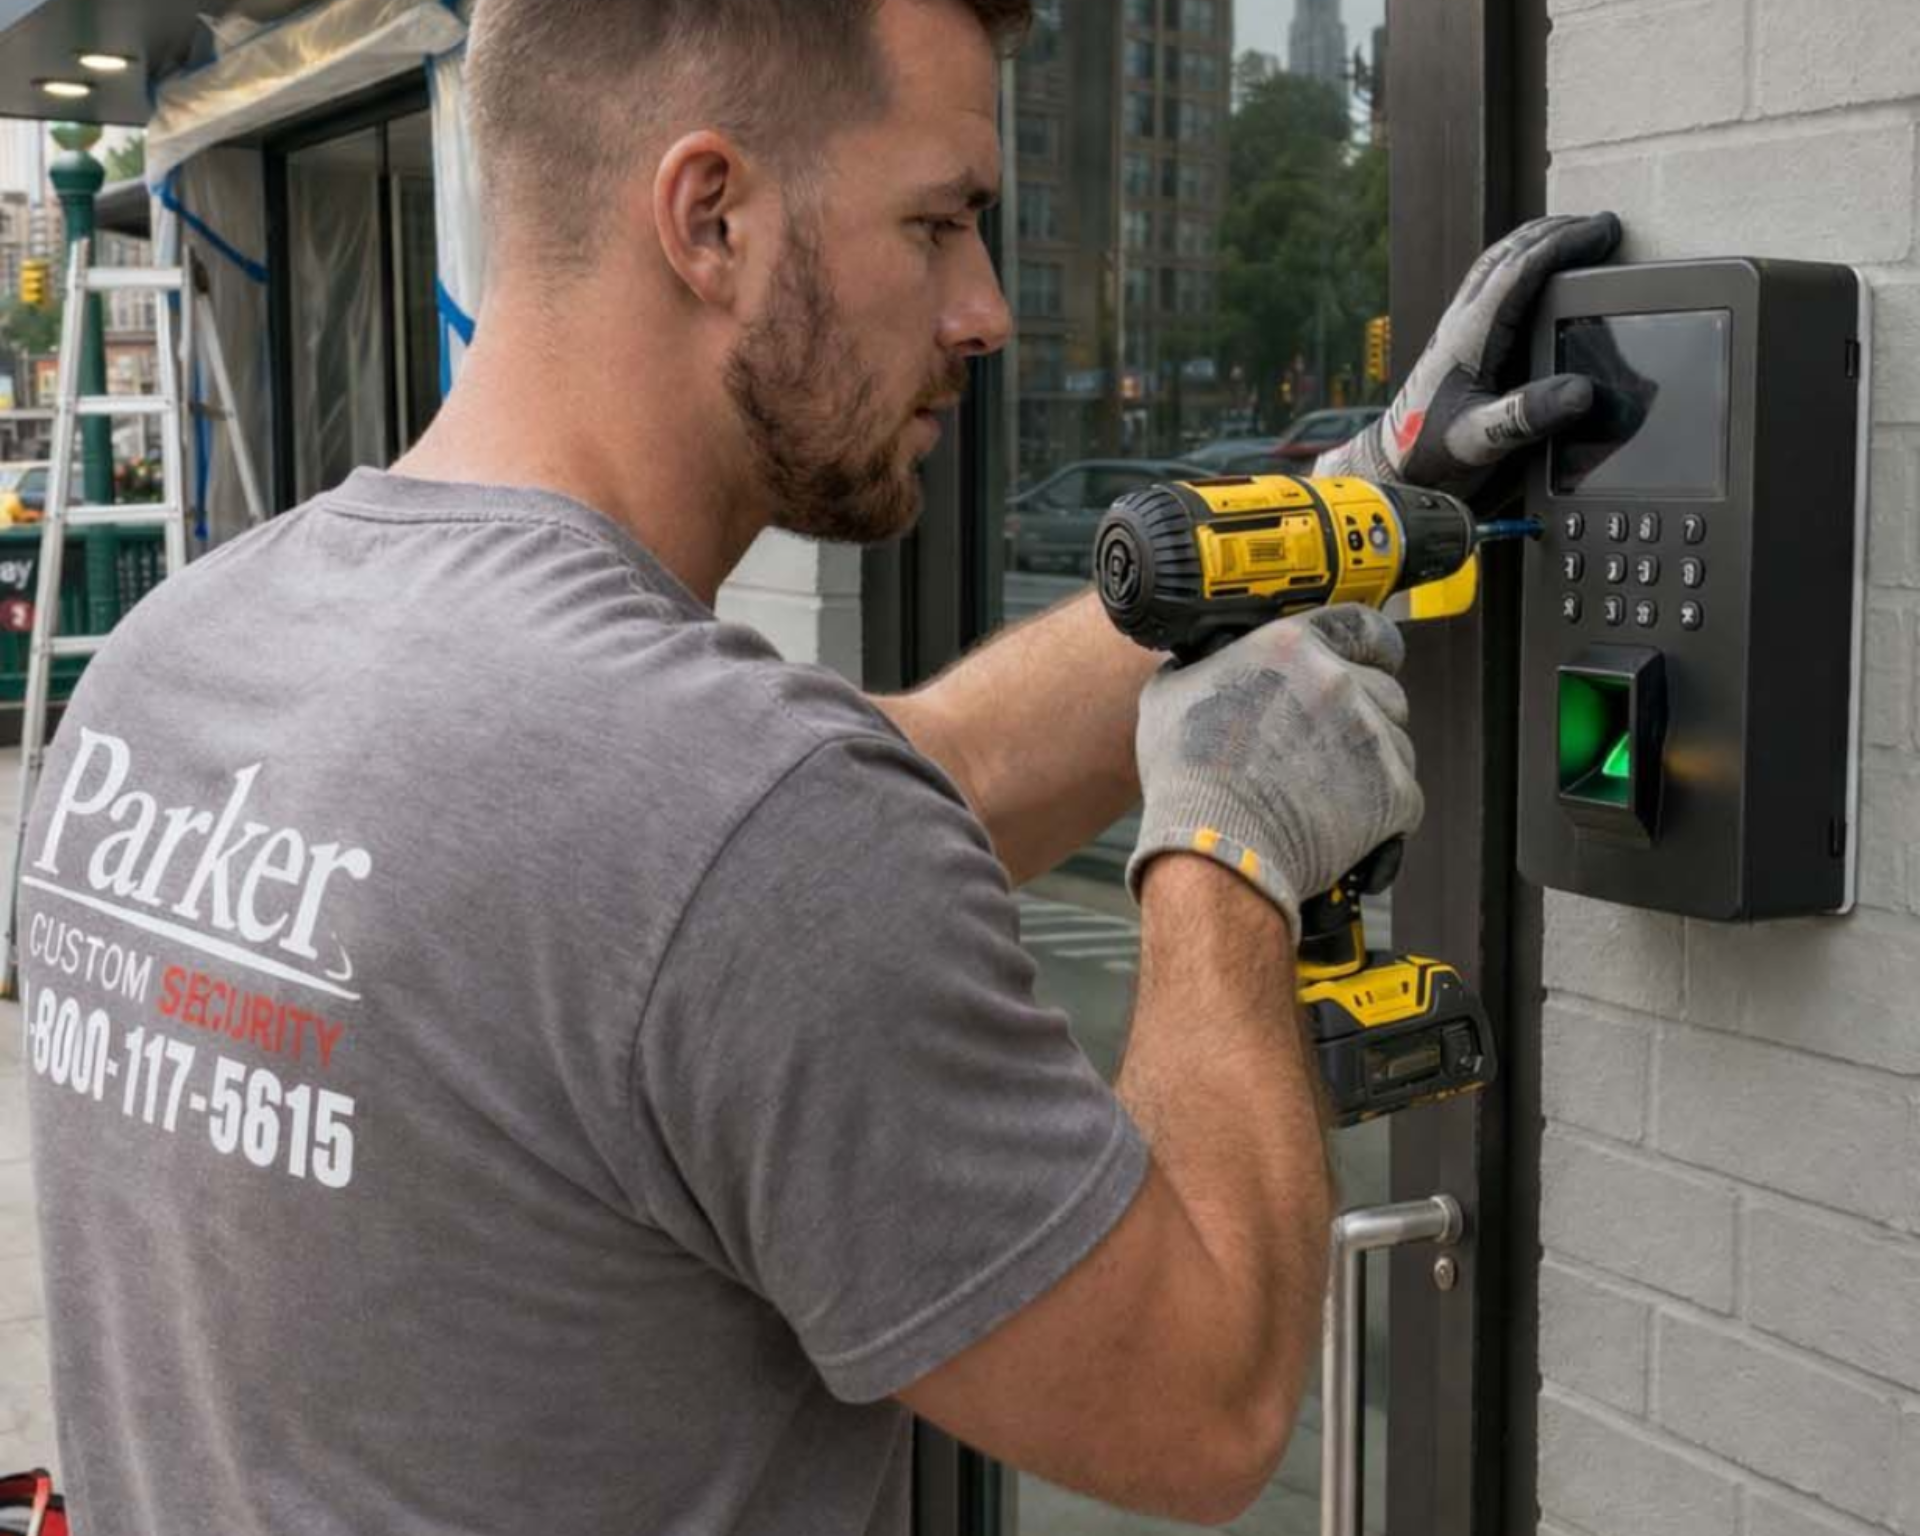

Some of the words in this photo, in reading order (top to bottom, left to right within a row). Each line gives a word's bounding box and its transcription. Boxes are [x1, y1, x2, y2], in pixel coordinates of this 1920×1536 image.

[32, 726, 372, 960] Parker
[29, 911, 153, 1004] CUSTOM
[155, 964, 346, 1071] SECURITY
